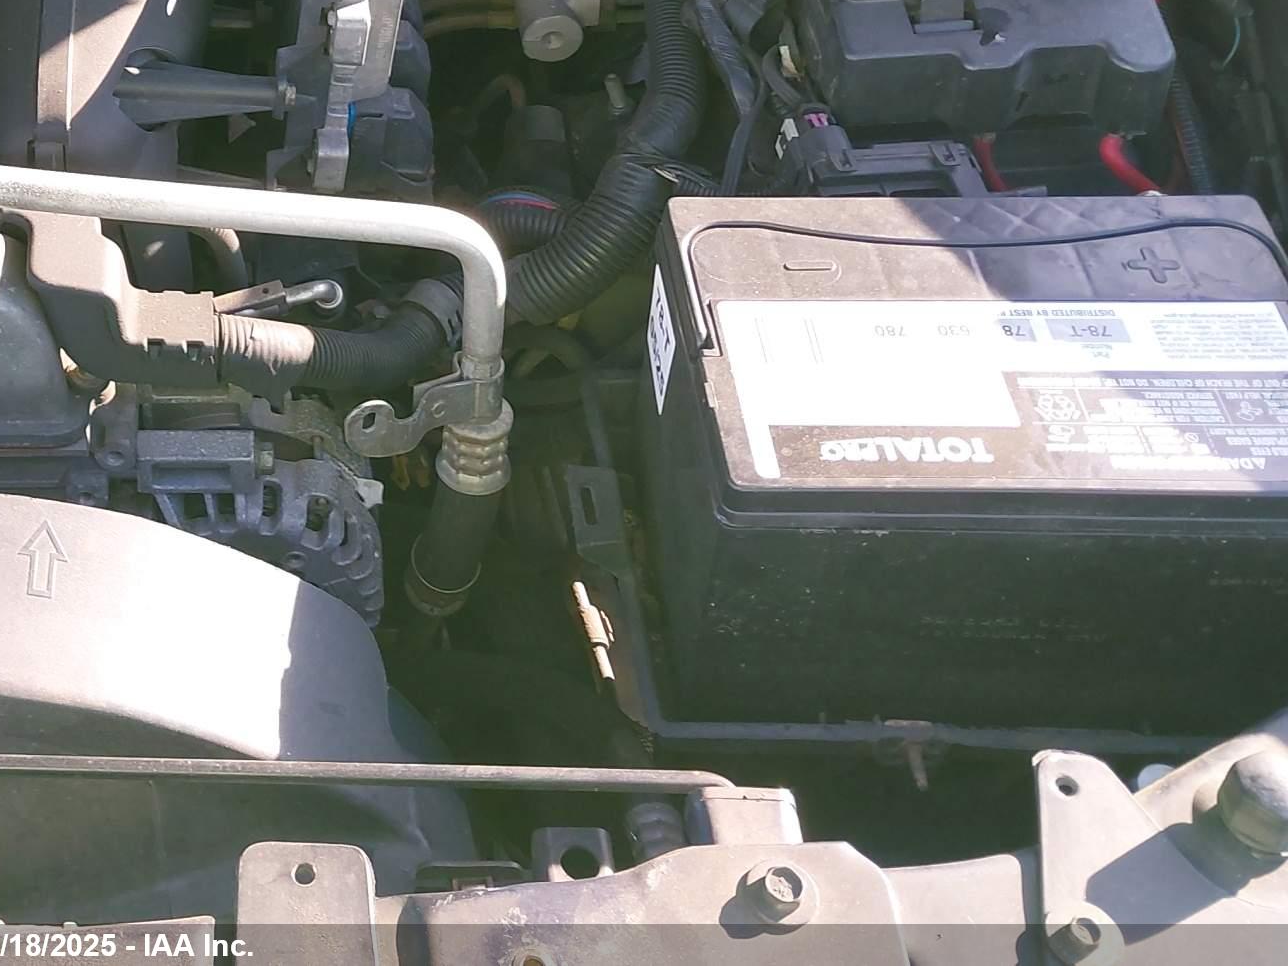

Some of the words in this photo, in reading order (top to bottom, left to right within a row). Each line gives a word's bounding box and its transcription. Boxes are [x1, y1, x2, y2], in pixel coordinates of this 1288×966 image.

[1036, 309, 1049, 317] BY
[1052, 309, 1116, 317] DISTRIBUTED
[656, 286, 670, 353] 78-T
[874, 325, 906, 337] 780
[1002, 325, 1026, 337] 78
[1069, 325, 1112, 337] 78-T
